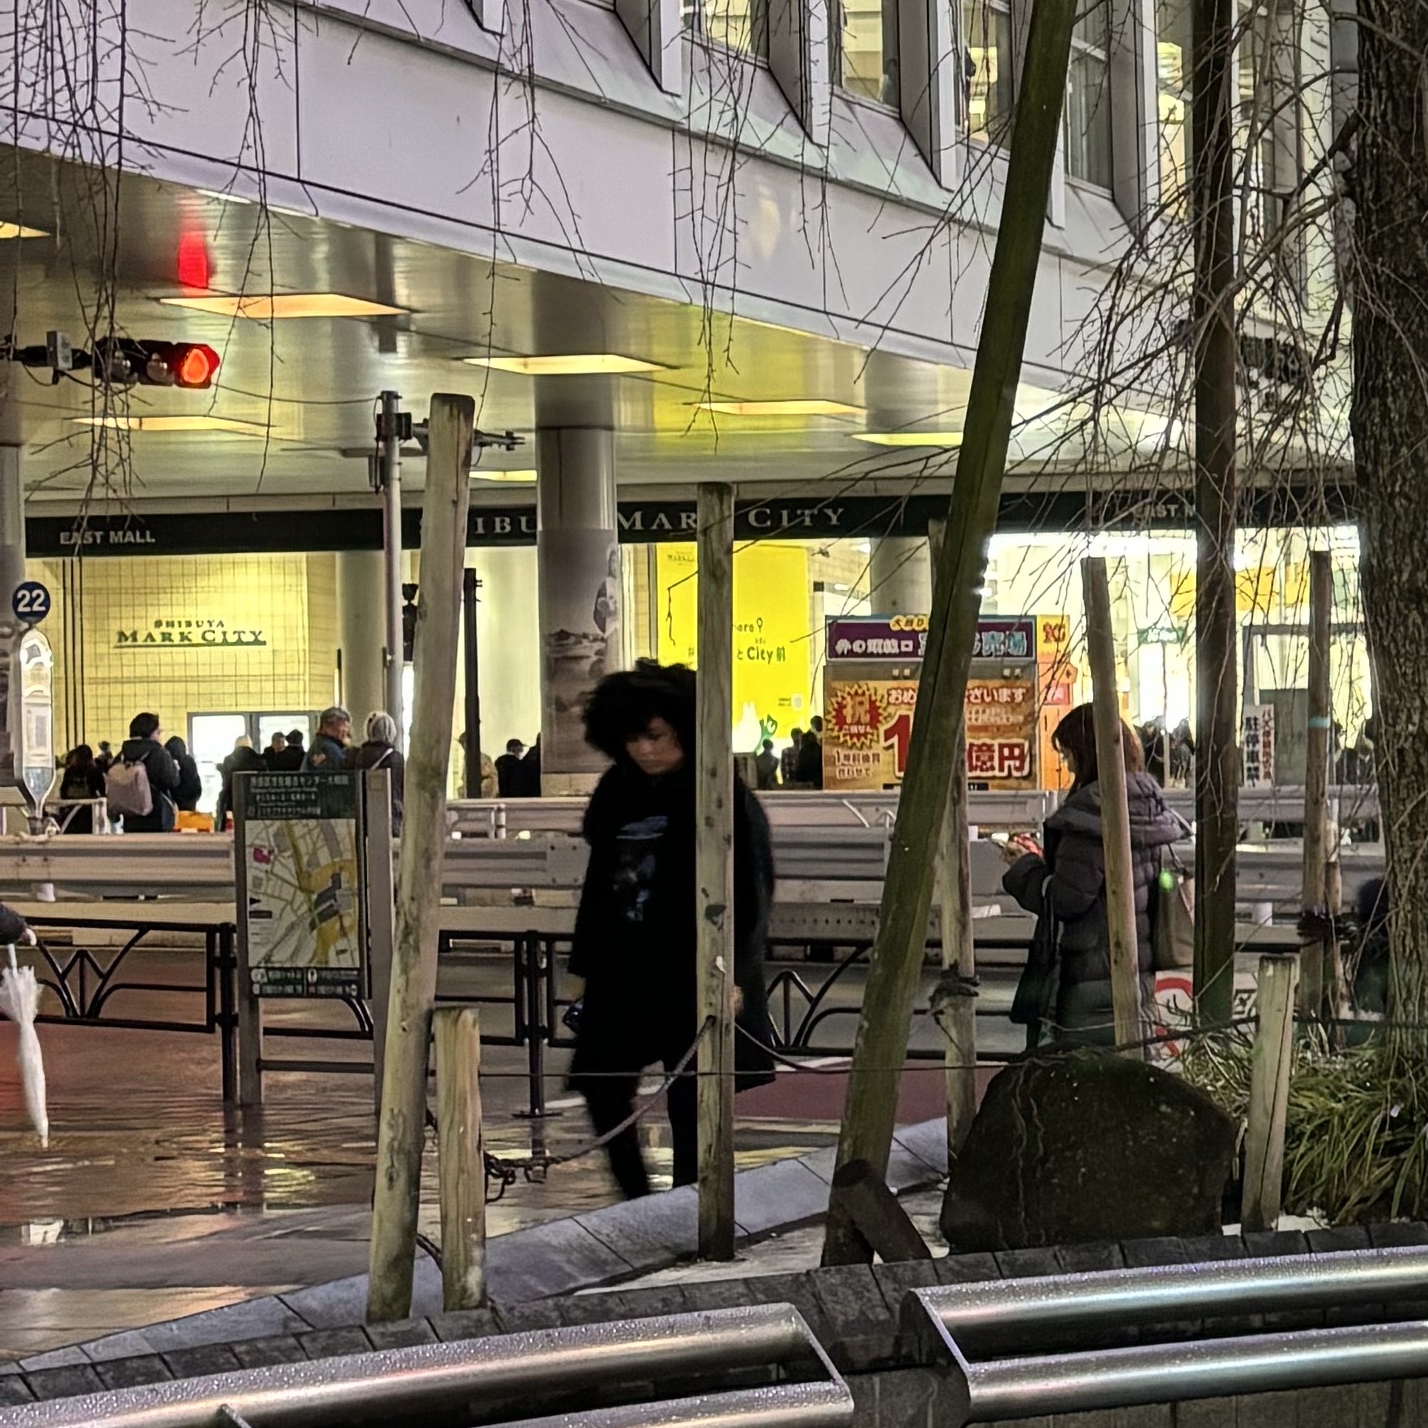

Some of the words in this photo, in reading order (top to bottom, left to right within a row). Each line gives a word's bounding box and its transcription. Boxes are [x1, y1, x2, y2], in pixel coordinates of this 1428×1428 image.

[747, 505, 847, 529] CITY
[60, 531, 104, 546] EAST
[109, 530, 156, 544] MALL
[16, 589, 46, 612] 22
[116, 629, 193, 644] MARK
